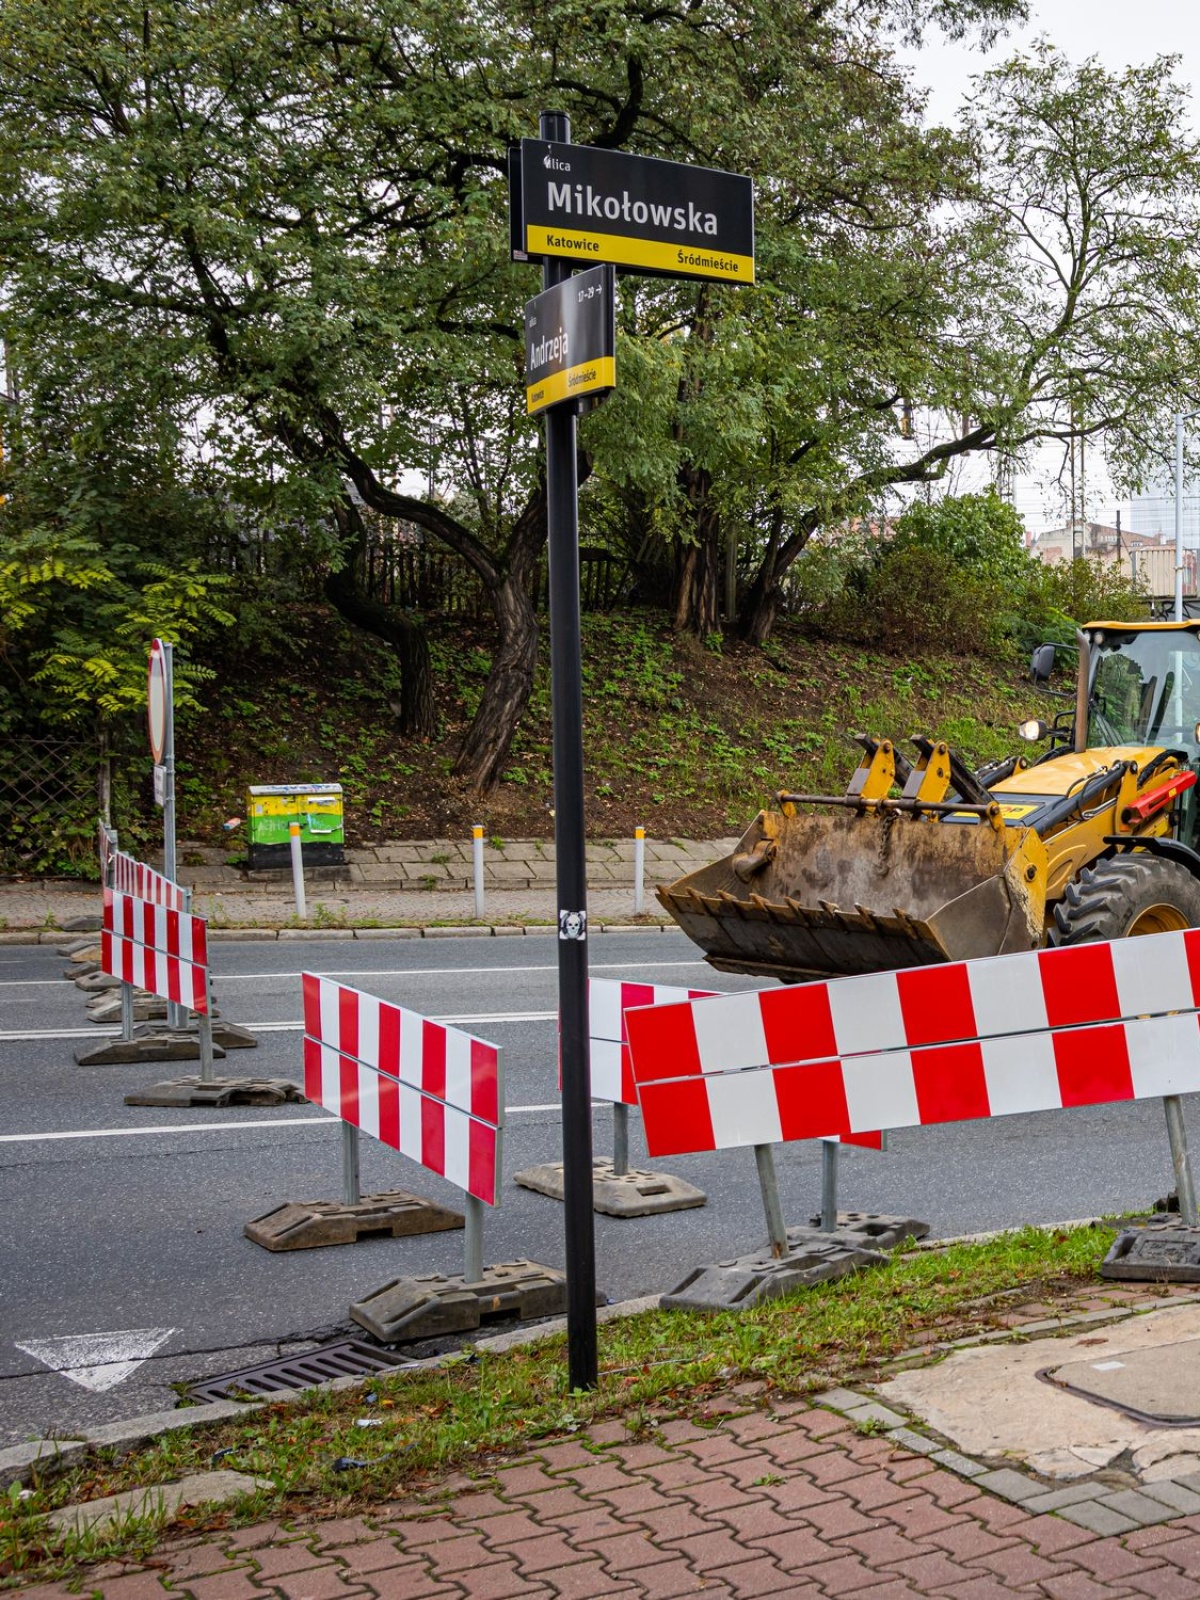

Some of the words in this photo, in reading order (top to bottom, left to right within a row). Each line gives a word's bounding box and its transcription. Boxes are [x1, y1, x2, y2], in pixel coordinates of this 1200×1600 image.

[548, 181, 718, 236] Mikołowska
[547, 235, 600, 252] Katowice
[677, 249, 739, 272] Śródmieście
[531, 328, 568, 370] Andrzeja
